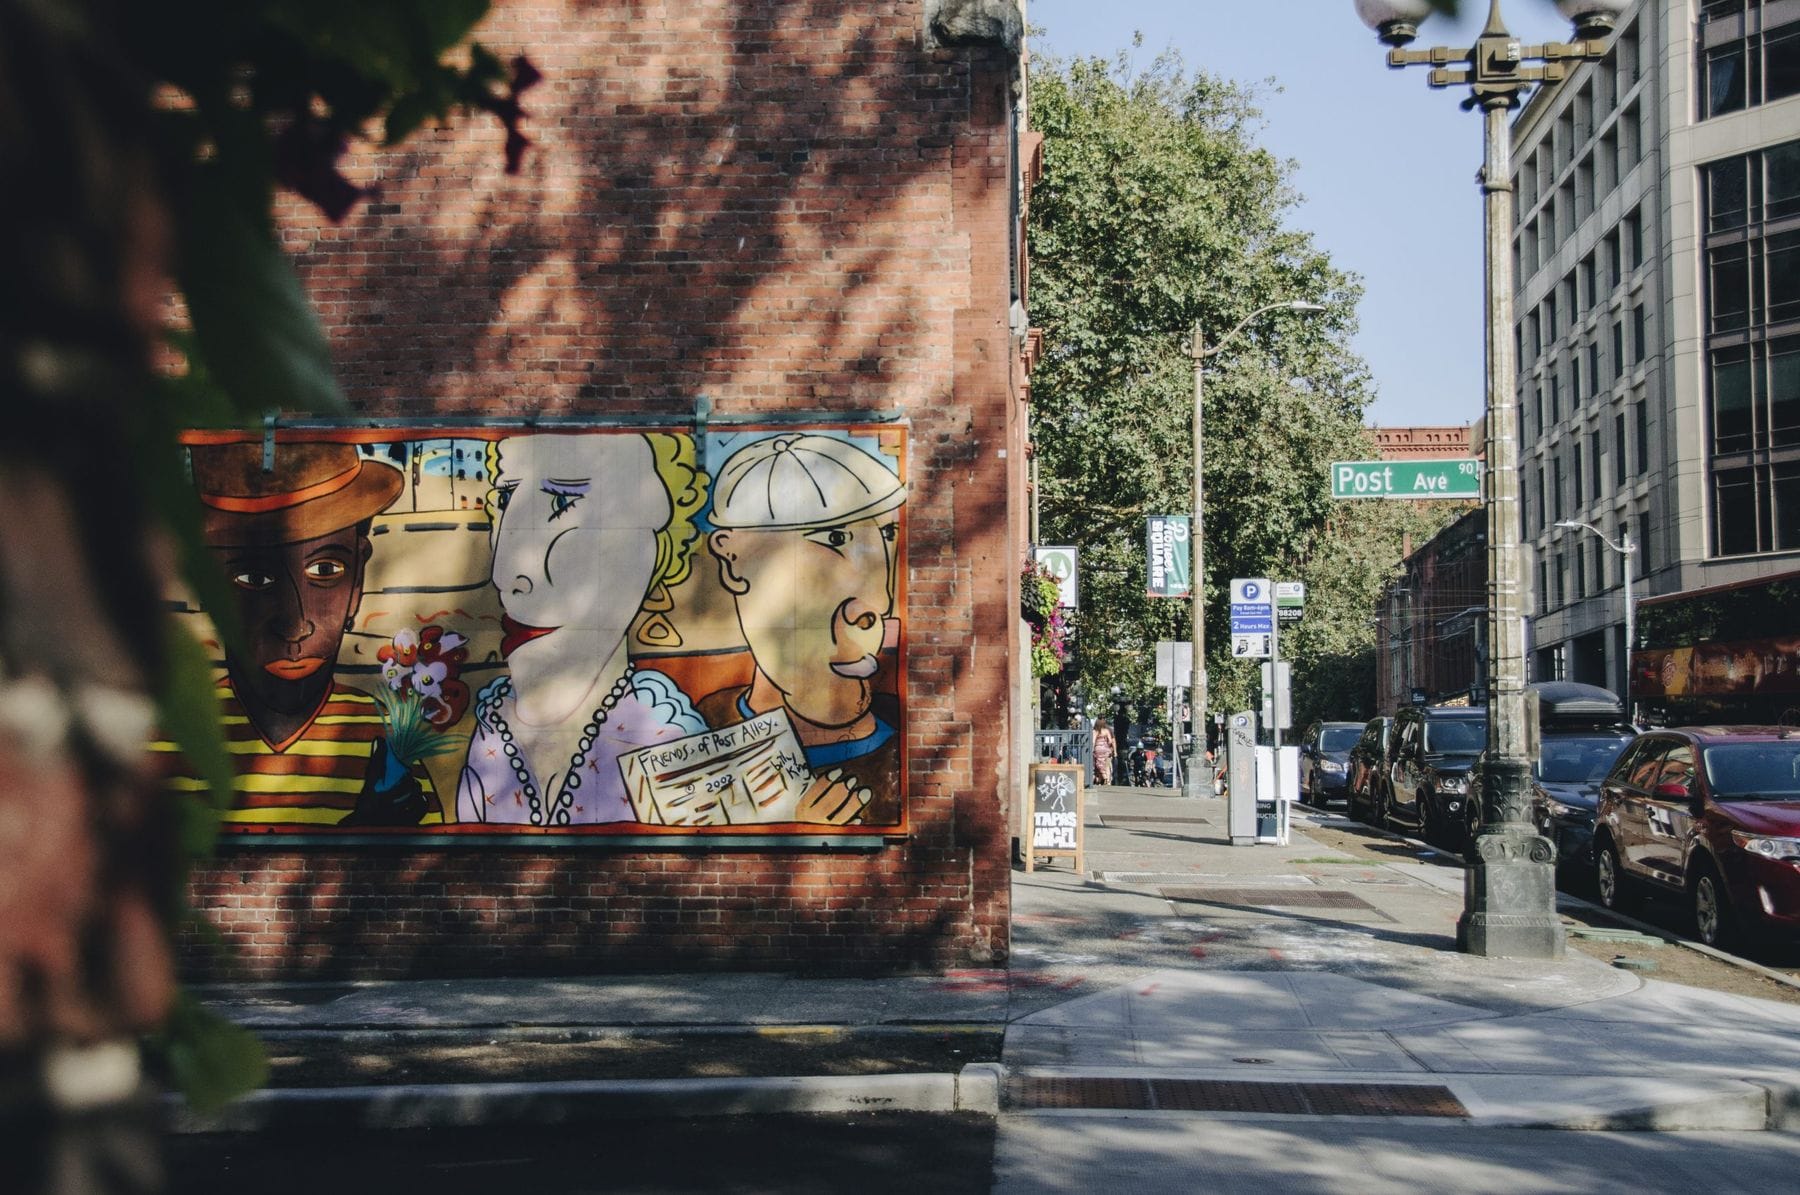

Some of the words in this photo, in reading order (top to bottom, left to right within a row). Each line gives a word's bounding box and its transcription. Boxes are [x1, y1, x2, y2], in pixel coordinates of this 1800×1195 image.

[1458, 463, 1473, 475] 90
[1339, 467, 1393, 493] Post
[1413, 473, 1448, 490] Ave
[1151, 521, 1164, 588] SQUARE
[1233, 621, 1240, 630] 2
[698, 736, 710, 755] of
[705, 774, 736, 793] 2002
